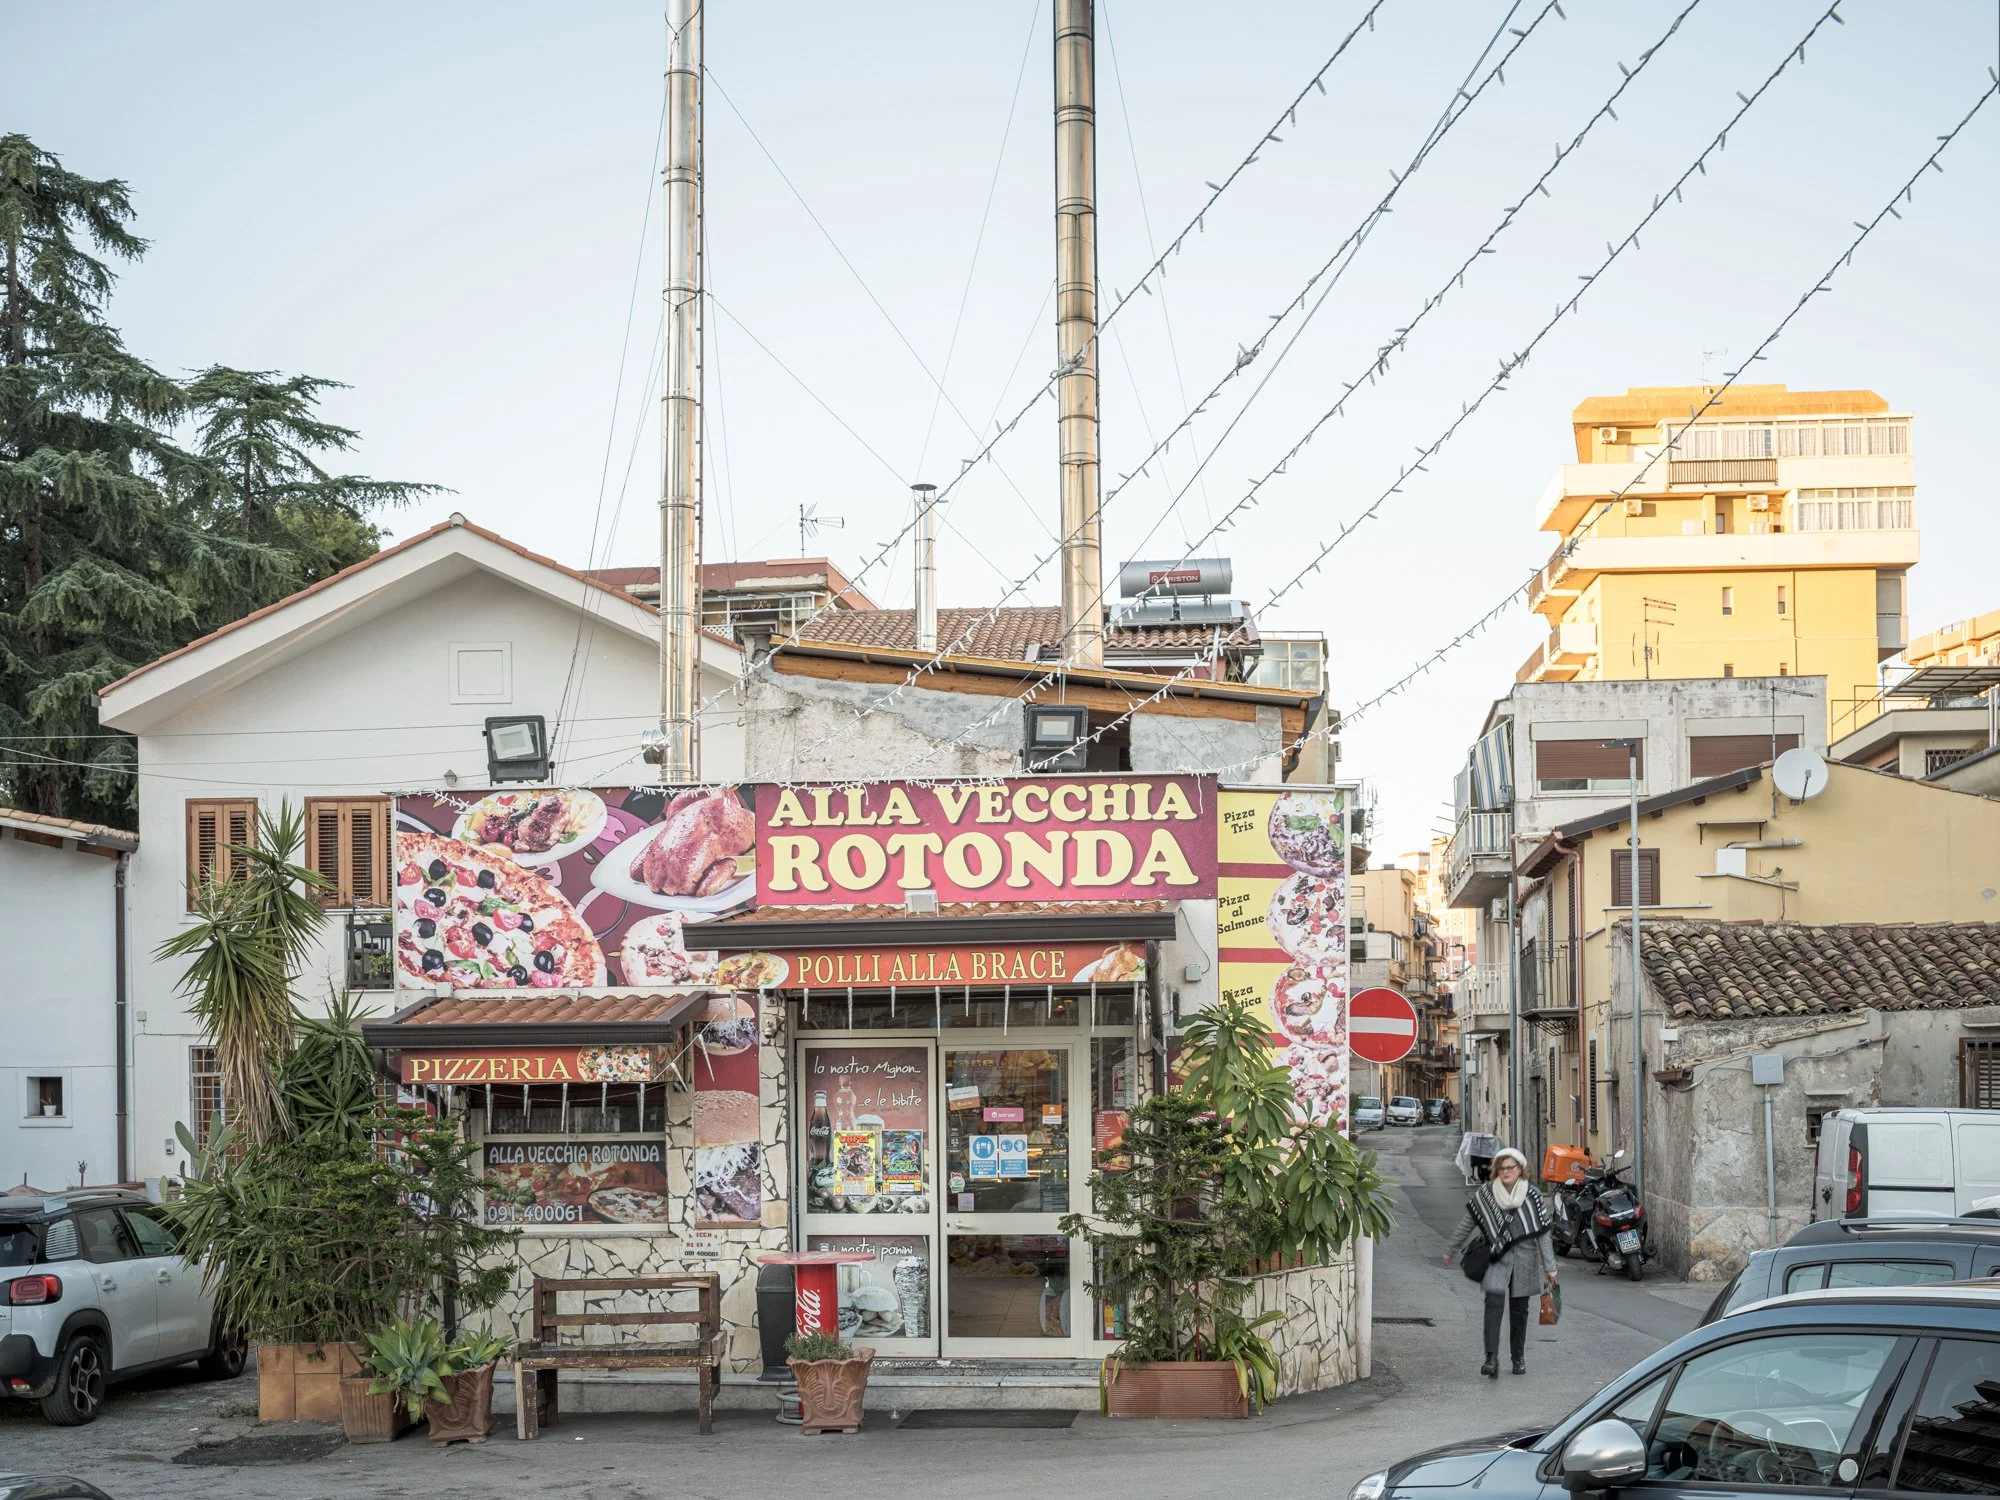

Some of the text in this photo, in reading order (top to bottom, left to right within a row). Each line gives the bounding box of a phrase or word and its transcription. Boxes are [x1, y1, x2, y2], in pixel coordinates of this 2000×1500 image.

[767, 782, 1198, 827] ALLA VECCHIA
[1224, 808, 1255, 824] Pizza
[1231, 821, 1254, 835] Tris
[767, 828, 1199, 892] ROTONDA
[1218, 893, 1250, 908] Pizza
[1231, 905, 1244, 918] al
[1217, 915, 1264, 934] Salmone
[797, 950, 1066, 984] POLLI ALLA BRACE
[410, 1057, 572, 1081] PIZZERIA
[876, 1088, 887, 1107] le
[891, 1089, 922, 1107] bibite
[489, 1145, 660, 1164] ALLA VECCHIA ROTONDA
[487, 1204, 583, 1222] 091.400061
[881, 1245, 913, 1263] panini
